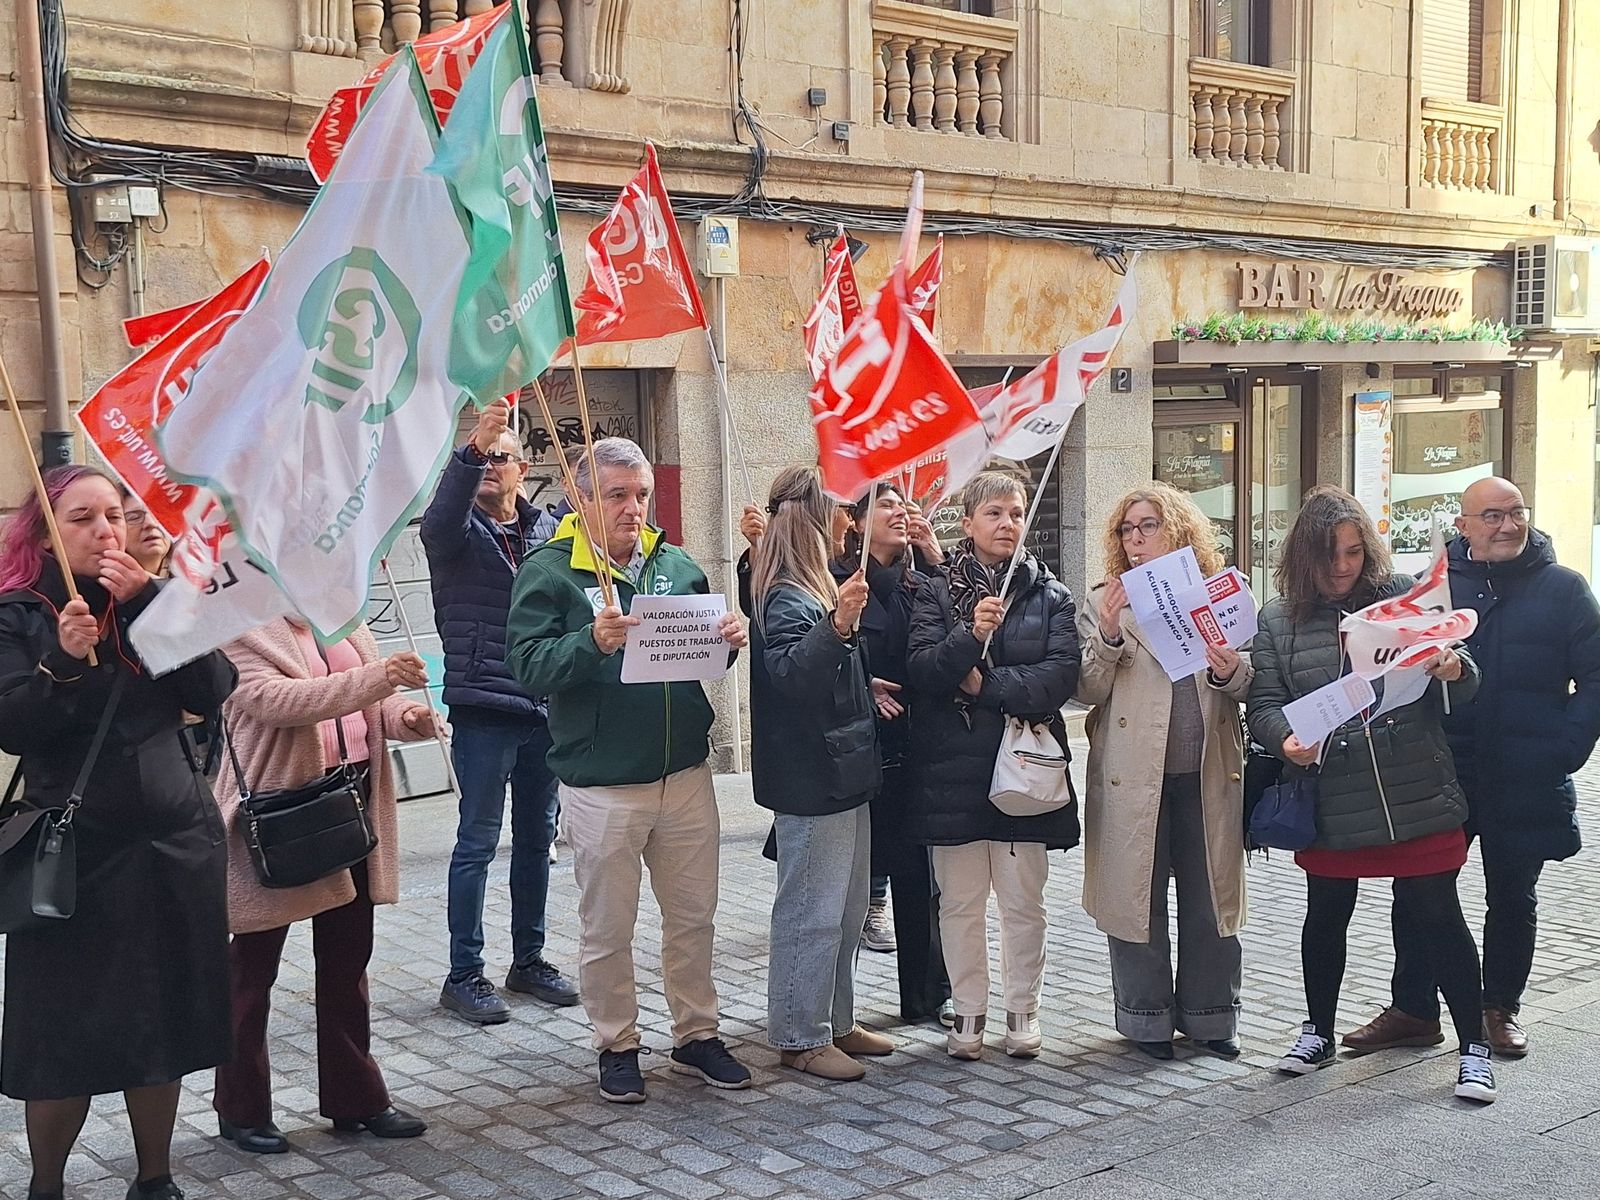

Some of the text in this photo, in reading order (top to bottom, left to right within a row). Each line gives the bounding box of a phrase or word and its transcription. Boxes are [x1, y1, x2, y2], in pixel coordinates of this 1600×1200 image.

[1236, 262, 1463, 319] BAR La Fragua
[1115, 369, 1129, 391] 2
[1166, 455, 1211, 472] La Fragua
[654, 581, 673, 592] CSIF
[1208, 579, 1229, 593] COO
[642, 608, 721, 620] VALORACIÓN JUSTA Y
[1146, 570, 1192, 656] ACUERDO MARCO YA!
[1160, 579, 1194, 639] ¡NEGOCIACIÓN
[1228, 604, 1240, 615] DE
[655, 623, 710, 634] ADECUADA DE
[1201, 613, 1219, 640] CCOO
[1222, 620, 1238, 630] YA!
[639, 637, 722, 648] PUESTOS DE TRABAJO
[650, 650, 710, 662] DE DIPUTACIÓN
